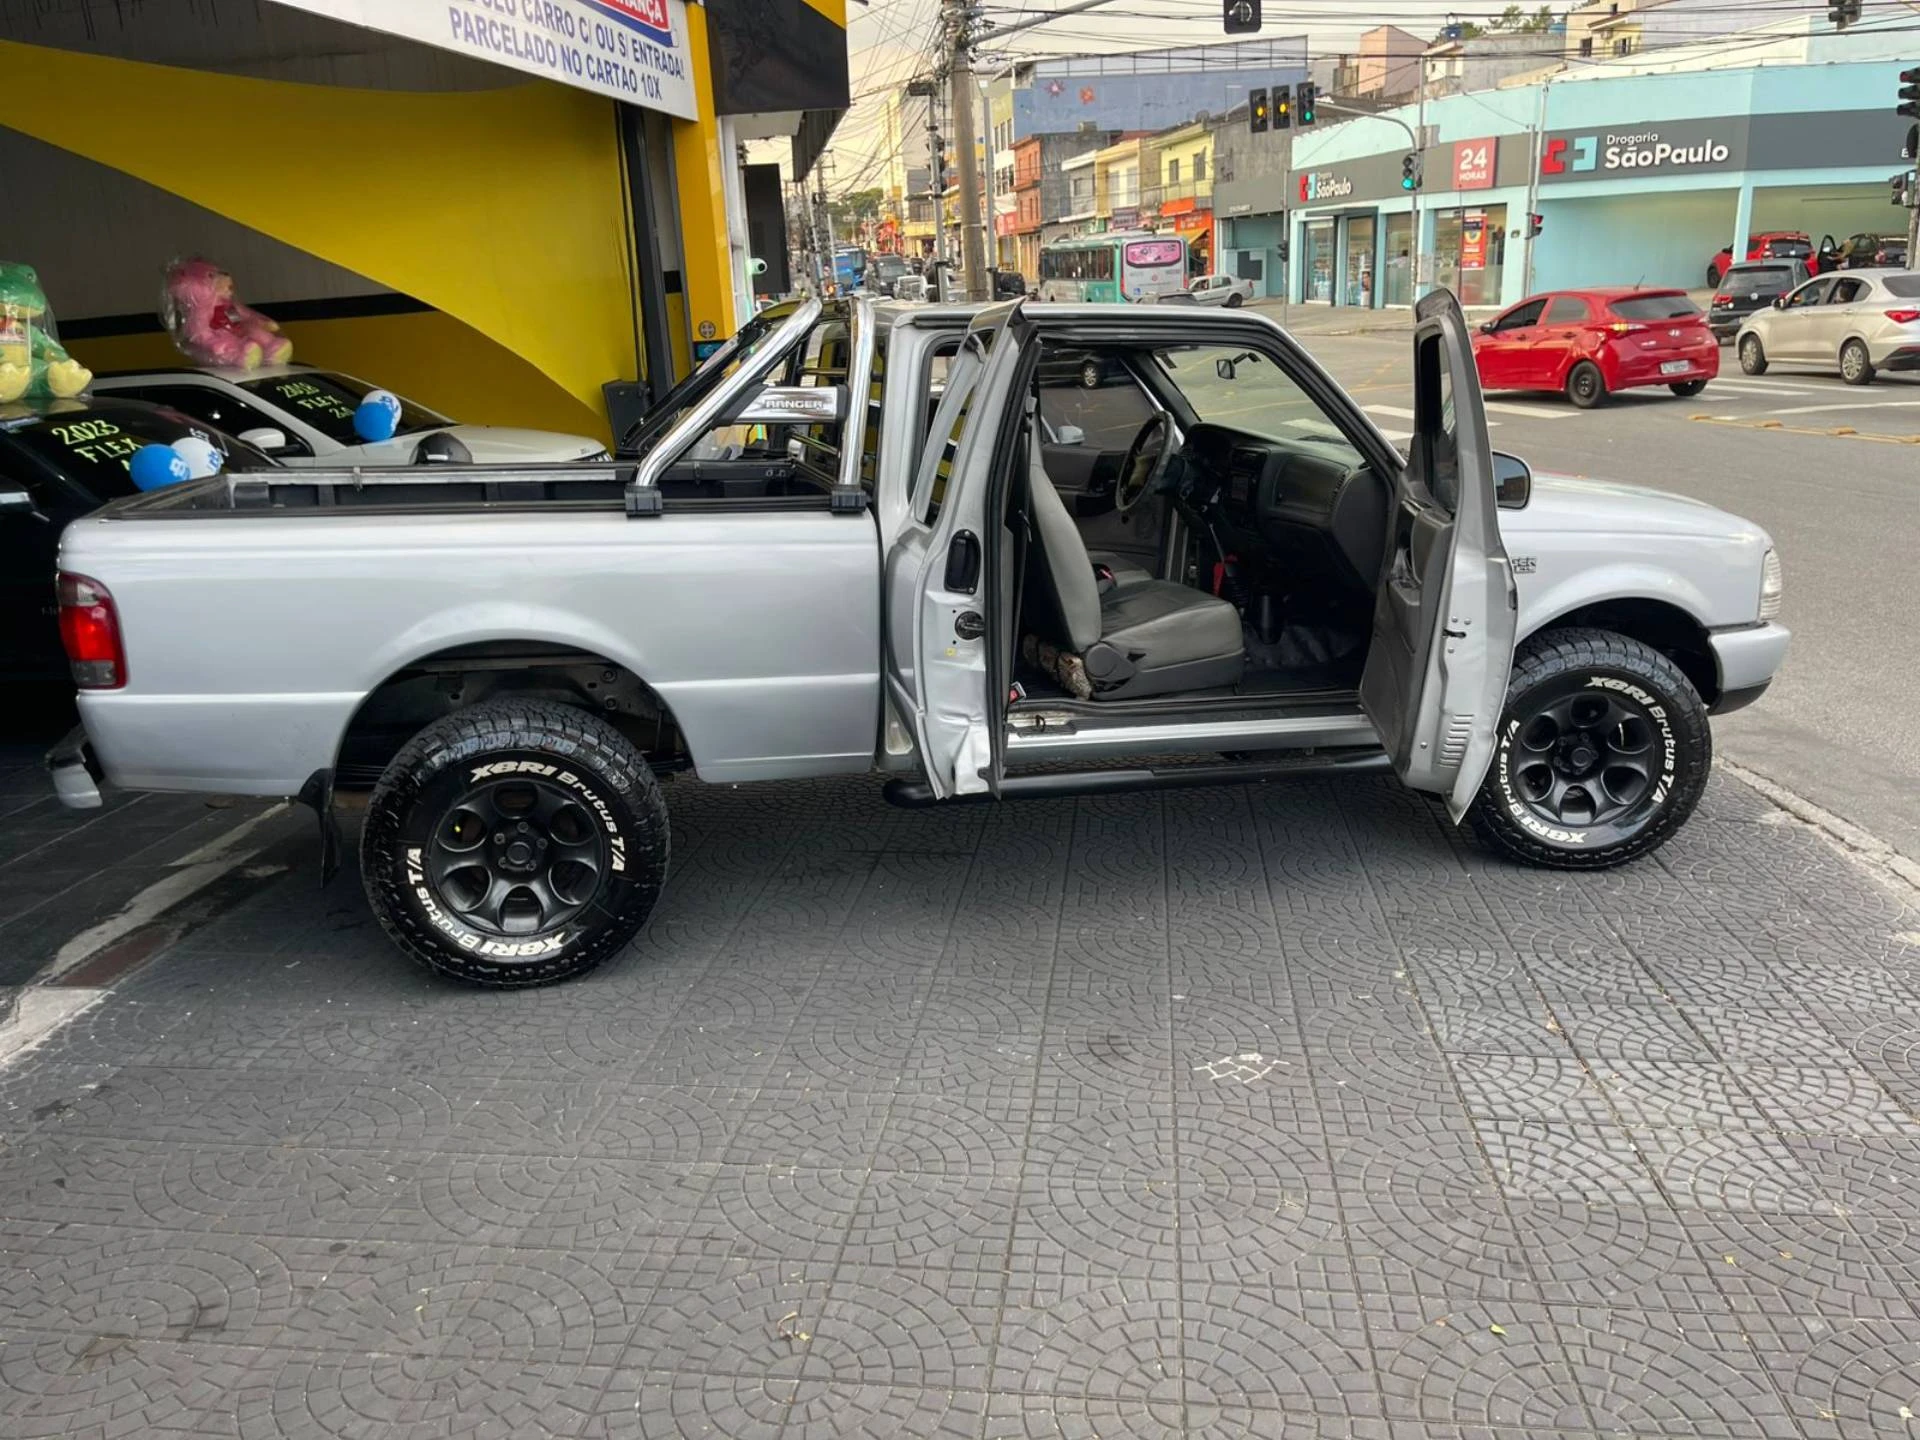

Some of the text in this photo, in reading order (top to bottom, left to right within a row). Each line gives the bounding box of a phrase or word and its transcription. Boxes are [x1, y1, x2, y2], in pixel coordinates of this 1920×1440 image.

[449, 6, 557, 68] PARCELADO
[561, 44, 583, 76] NO
[641, 73, 663, 100] 10X
[522, 0, 575, 39] CARRO
[595, 23, 615, 54] OU
[632, 38, 685, 80] ENTRADA!
[1606, 131, 1659, 146] Drogaria
[1460, 147, 1488, 171] 24
[765, 400, 824, 410] RANGER
[51, 419, 120, 445] 2023
[74, 437, 144, 464] FLEX
[1500, 719, 1521, 749] T/A
[1648, 706, 1676, 773] Brutus
[1500, 753, 1524, 820] Brutus
[1651, 773, 1675, 804] T/A
[556, 770, 618, 834] Brutus
[611, 836, 625, 872] T/A
[407, 848, 422, 885] T/A
[416, 887, 478, 950] Brutus
